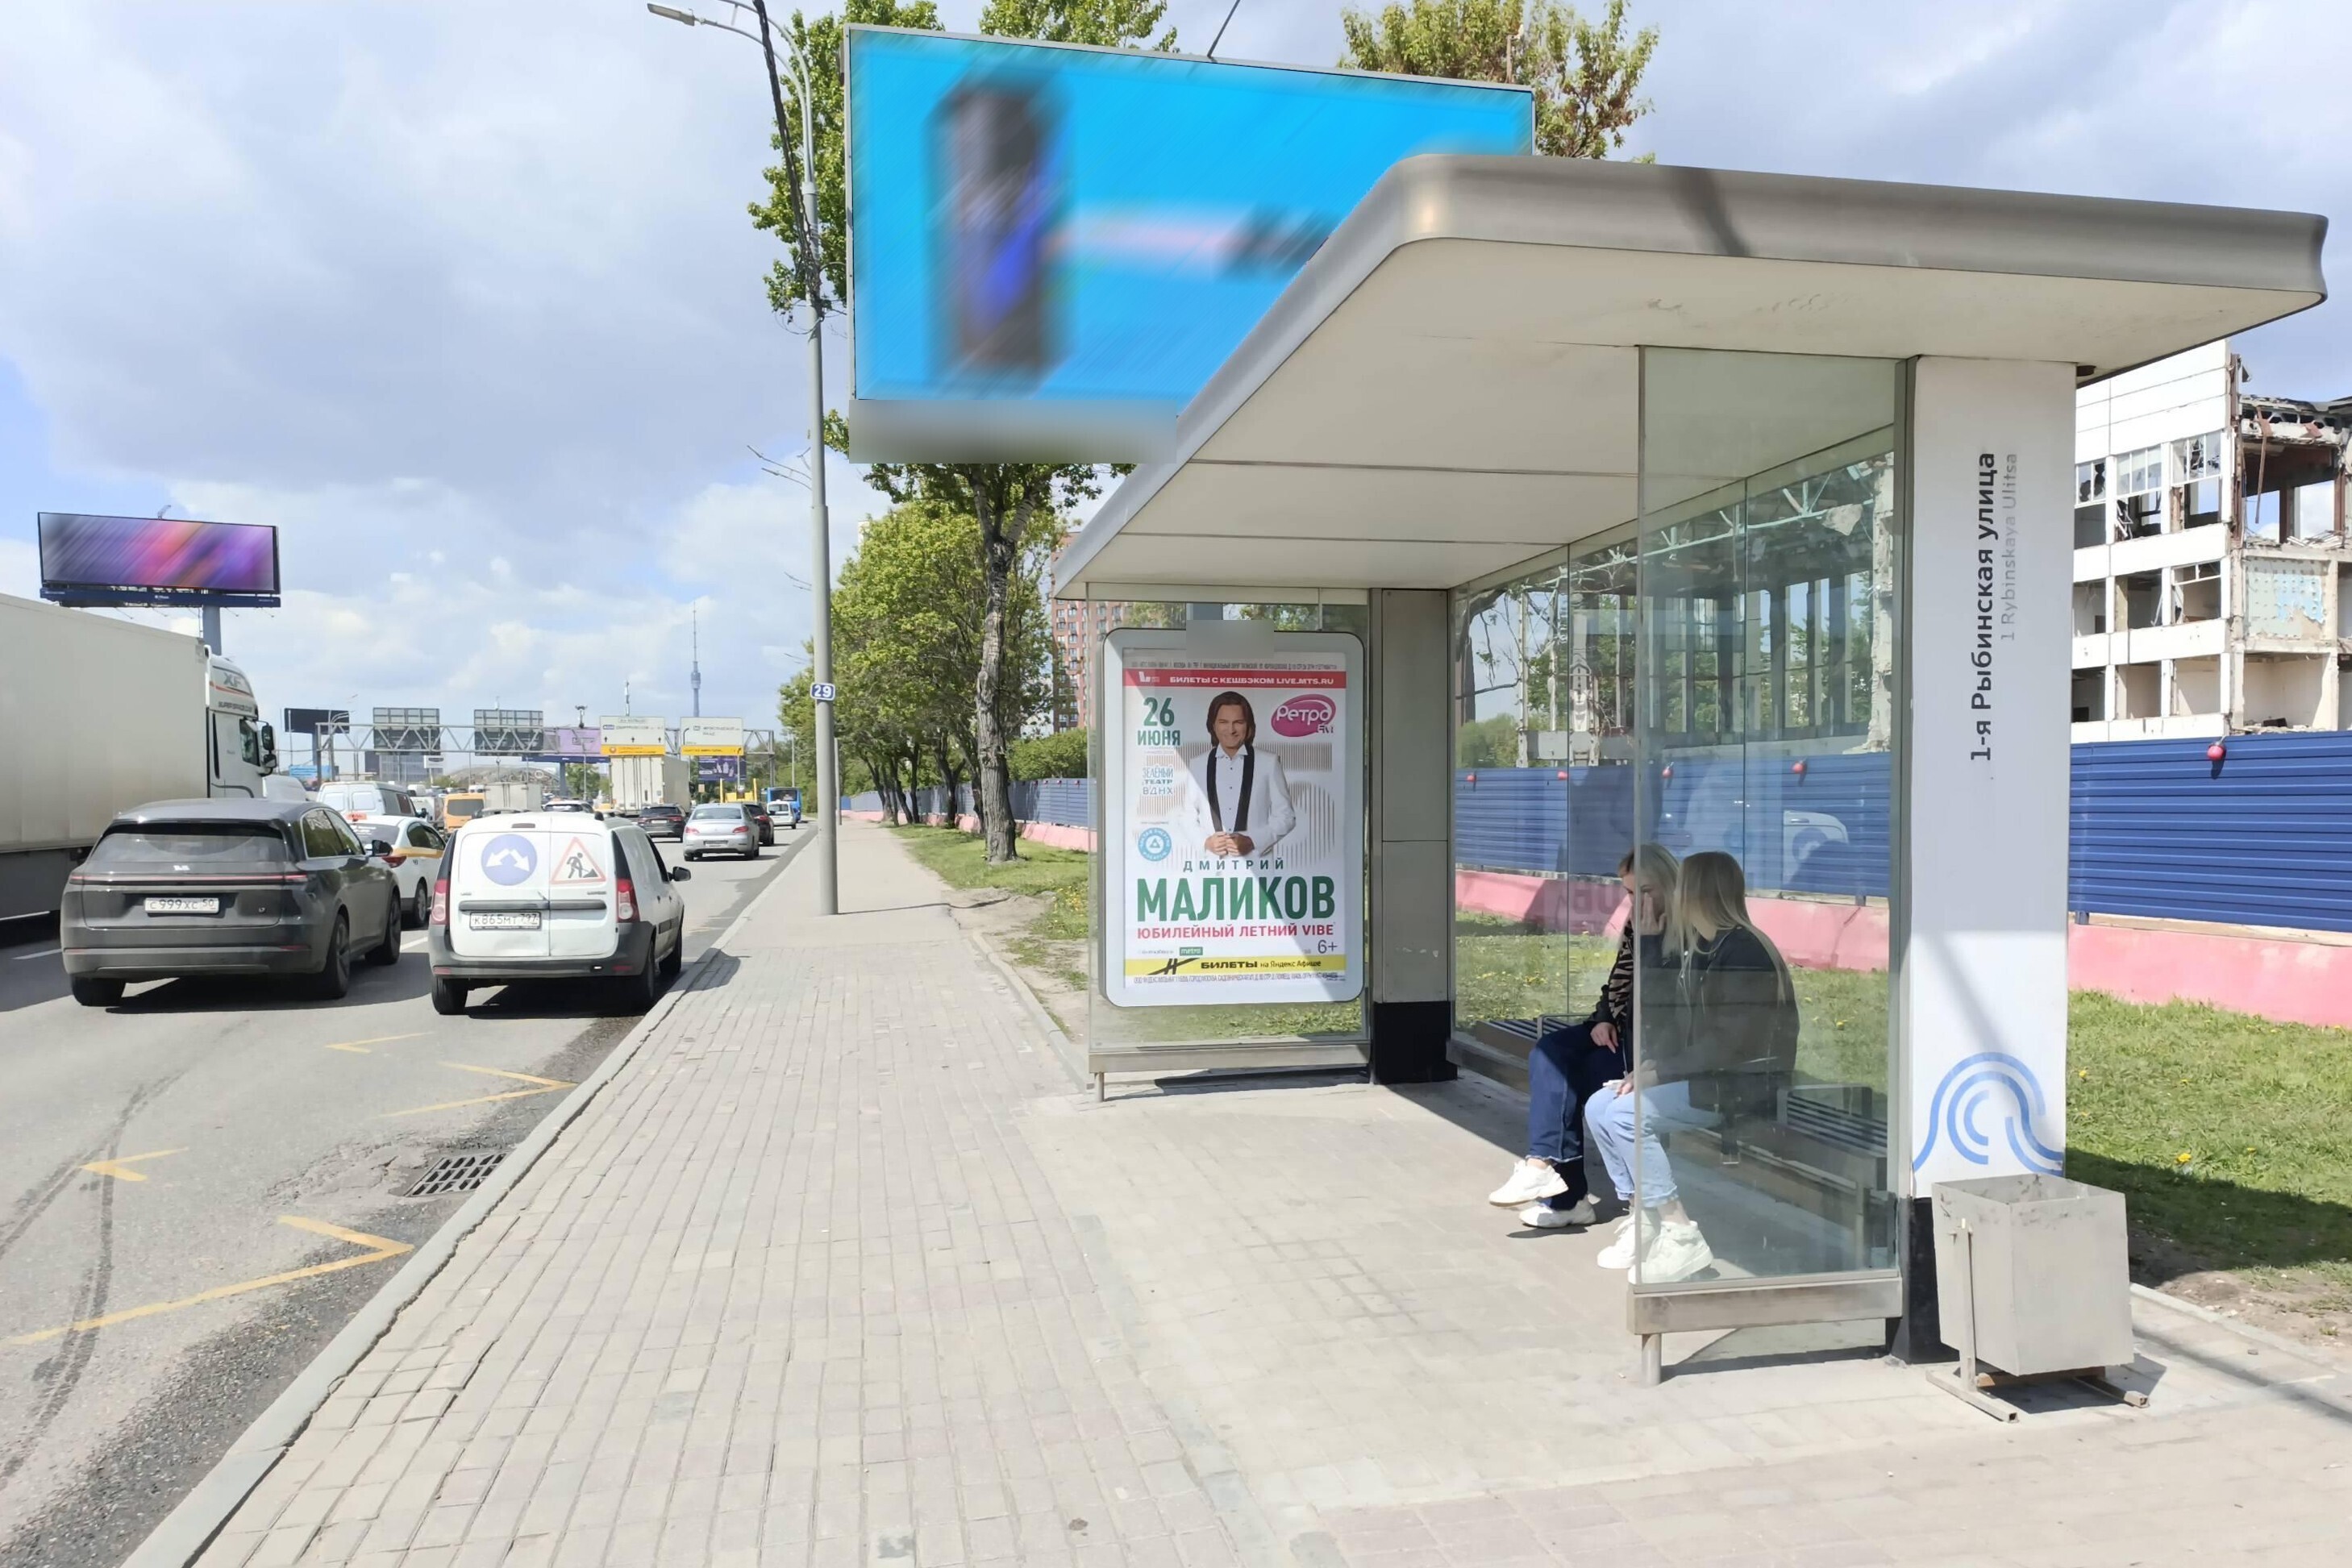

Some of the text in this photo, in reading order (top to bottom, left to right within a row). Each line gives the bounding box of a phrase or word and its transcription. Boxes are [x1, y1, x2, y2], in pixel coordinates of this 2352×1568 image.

[2000, 454, 2018, 641] 1 Rybinskaya Ulitsa
[1971, 453, 1998, 760] 1-я Рыбинская улица
[1170, 676, 1210, 684] БИЛЕТЫ
[1220, 676, 1274, 684] КЕШБЭКОМ
[814, 684, 831, 698] 29
[1143, 697, 1174, 726] 26
[1138, 730, 1180, 746] ИЮНЯ
[1143, 787, 1173, 795] ВДНХ
[1183, 858, 1284, 872] ДМИТРИЙ
[1137, 876, 1335, 921] МАЛИКОВ
[1138, 922, 1334, 939] ЮБИЛЕЙНЫЙ ЛЕТНИЙ VIBE
[1318, 939, 1338, 954] 6+
[1201, 961, 1258, 969] БИЛЕТЫ
[1271, 961, 1295, 969] Яндекс
[1297, 960, 1322, 968] Афише
